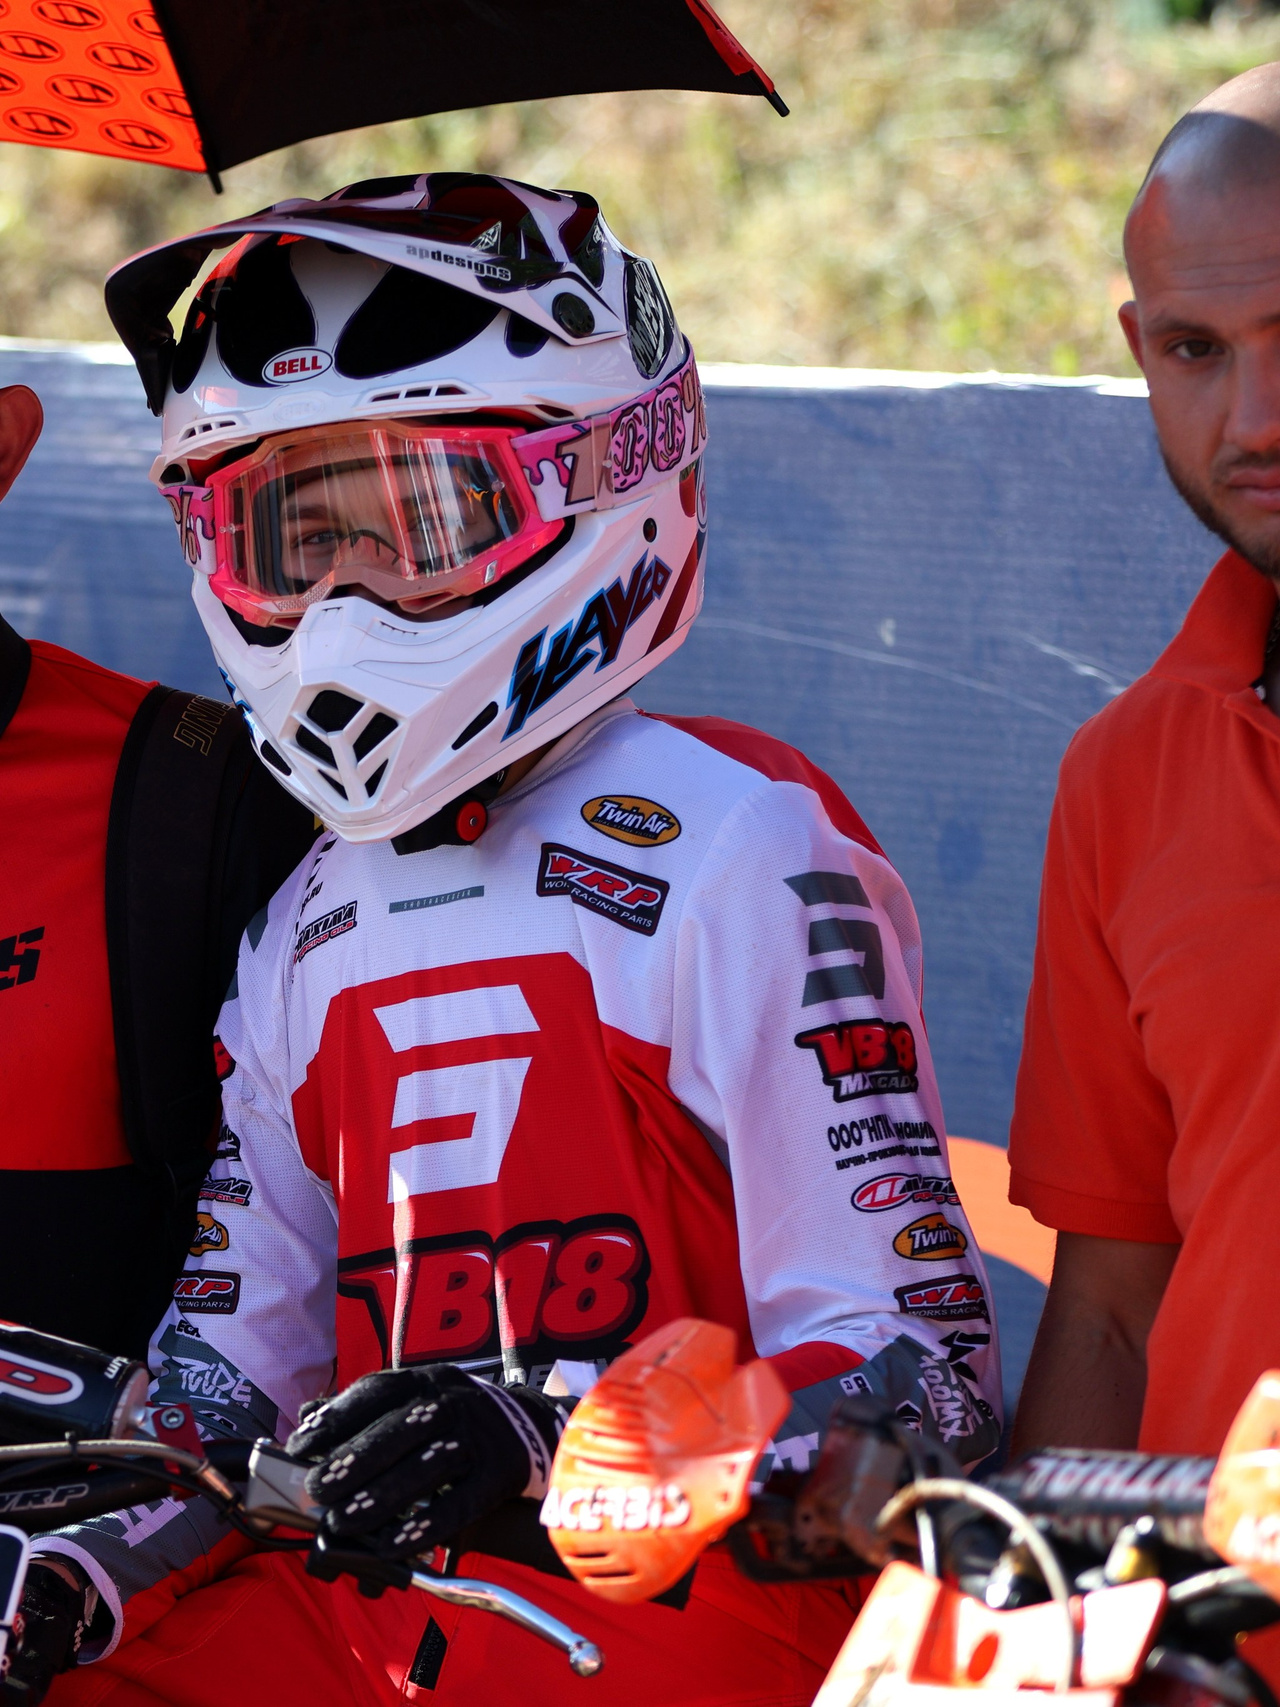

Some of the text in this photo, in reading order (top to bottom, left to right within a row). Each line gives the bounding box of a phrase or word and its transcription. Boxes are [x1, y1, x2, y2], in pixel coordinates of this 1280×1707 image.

[405, 244, 511, 281] apdesigns
[273, 355, 322, 377] BELL
[596, 800, 671, 835] Twin Air
[545, 852, 661, 910] WRP
[570, 886, 618, 915] RACING
[620, 910, 653, 928] PARTS
[201, 1301, 231, 1310] PARTS
